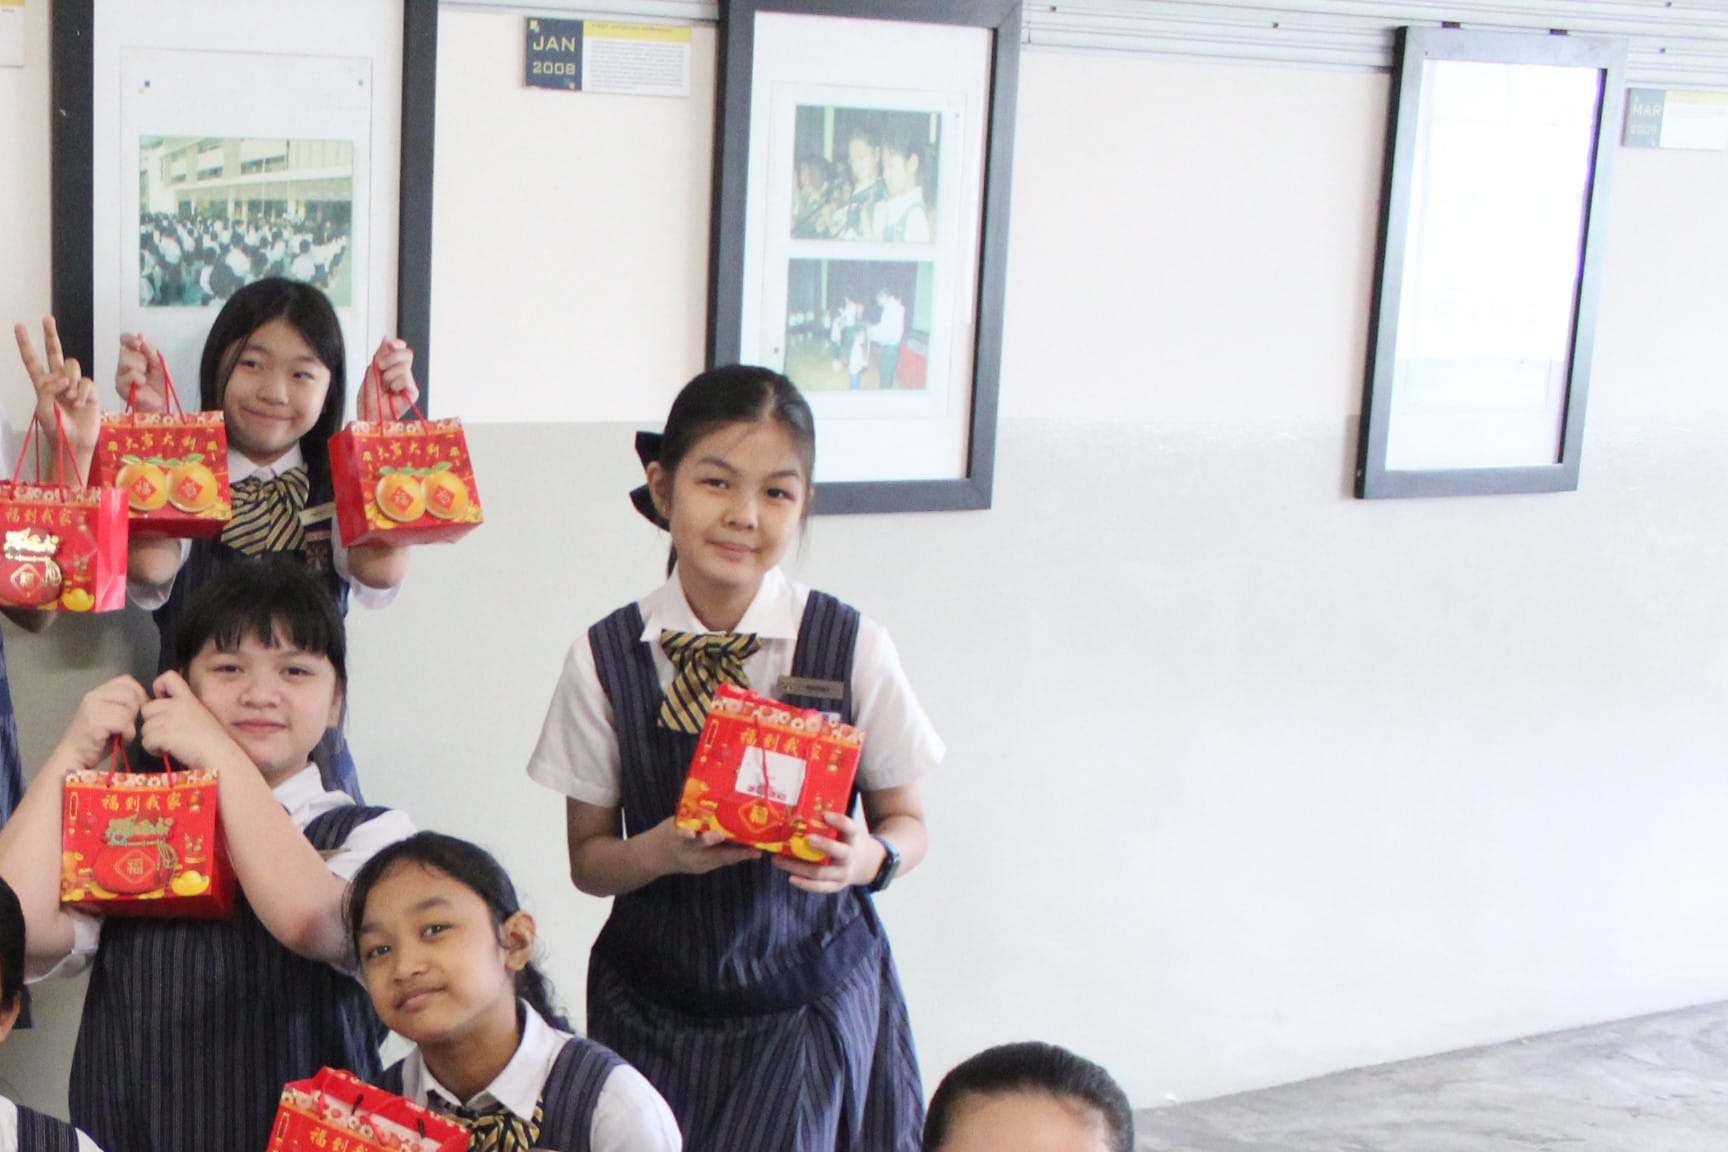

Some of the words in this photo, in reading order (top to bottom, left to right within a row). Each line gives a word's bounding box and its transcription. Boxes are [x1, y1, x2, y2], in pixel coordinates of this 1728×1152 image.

[533, 35, 576, 52] JAN
[532, 60, 576, 75] 2008
[1632, 104, 1661, 116] MAR
